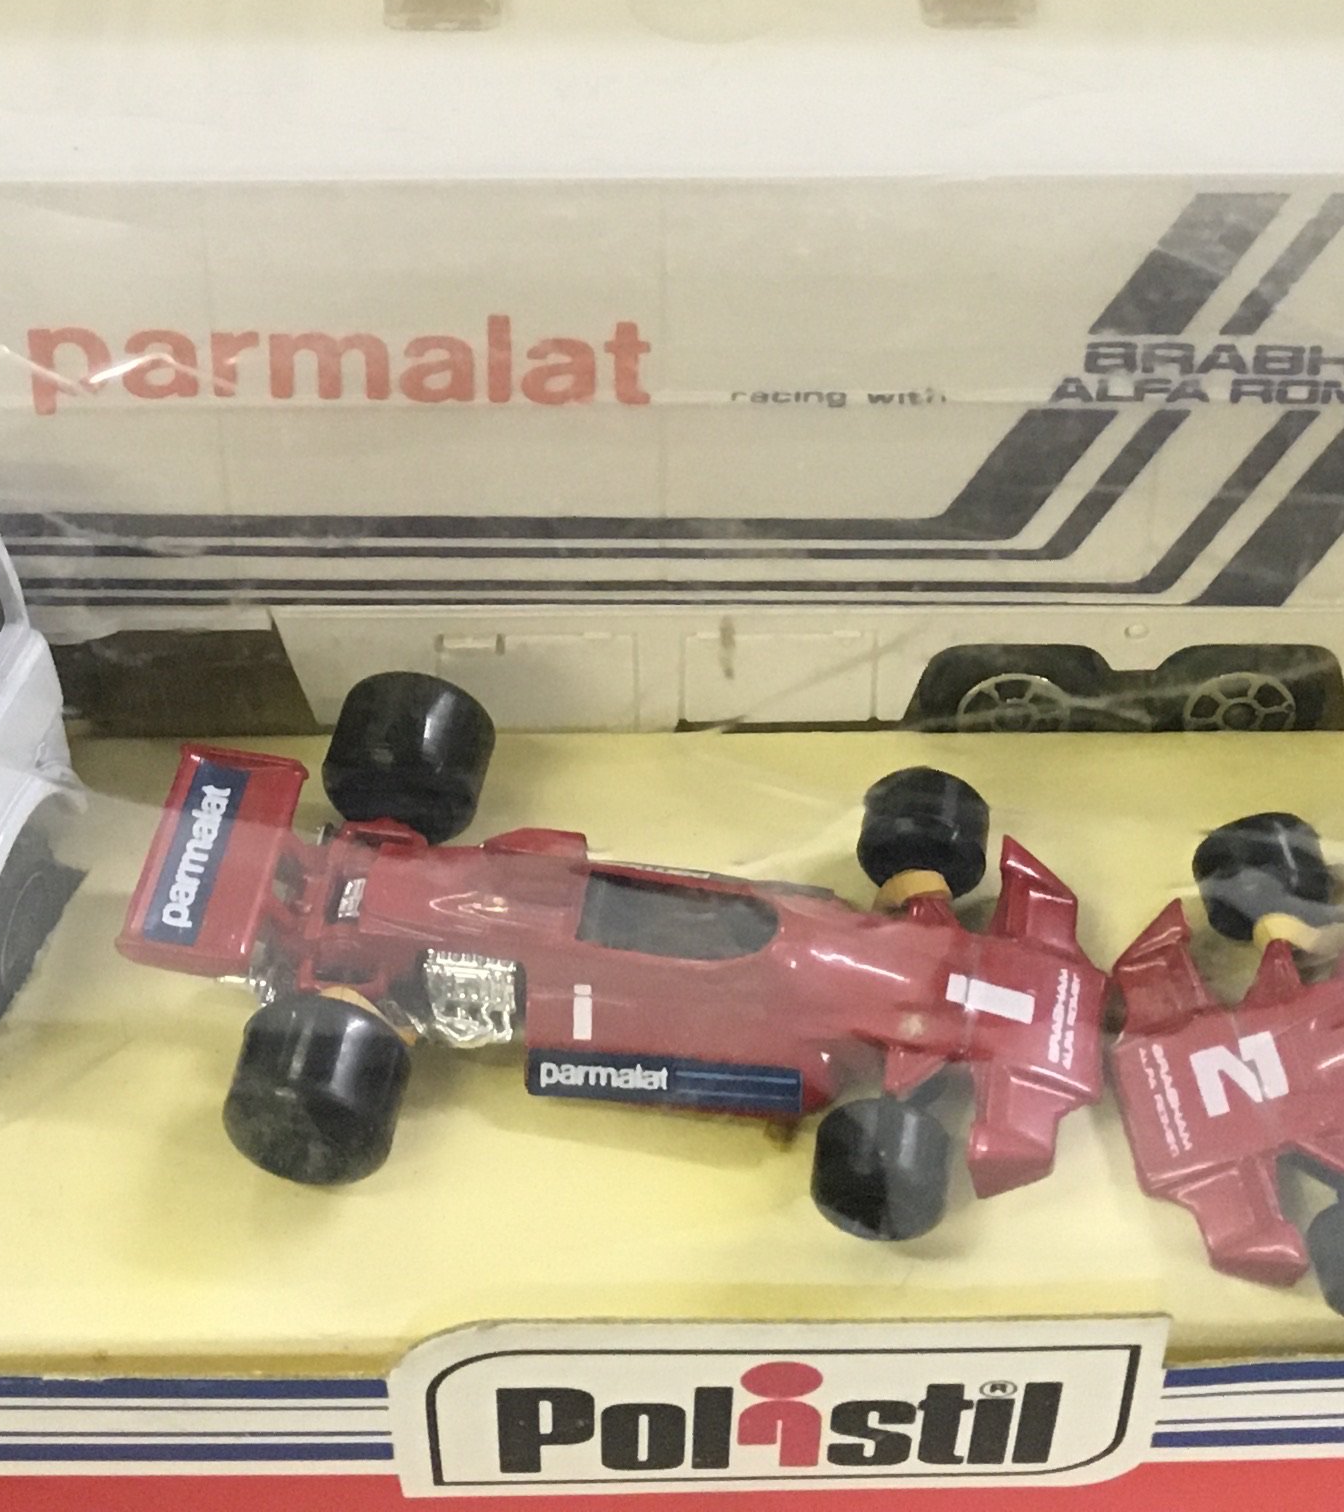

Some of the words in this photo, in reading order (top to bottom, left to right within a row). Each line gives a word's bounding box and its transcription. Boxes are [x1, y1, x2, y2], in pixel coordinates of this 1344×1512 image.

[27, 315, 651, 415] parmalat
[1050, 377, 1209, 404] ALFA
[731, 391, 846, 408] racing
[162, 784, 231, 928] parmalat
[540, 1061, 668, 1091] parmalat
[496, 1361, 1064, 1474] Polistil
